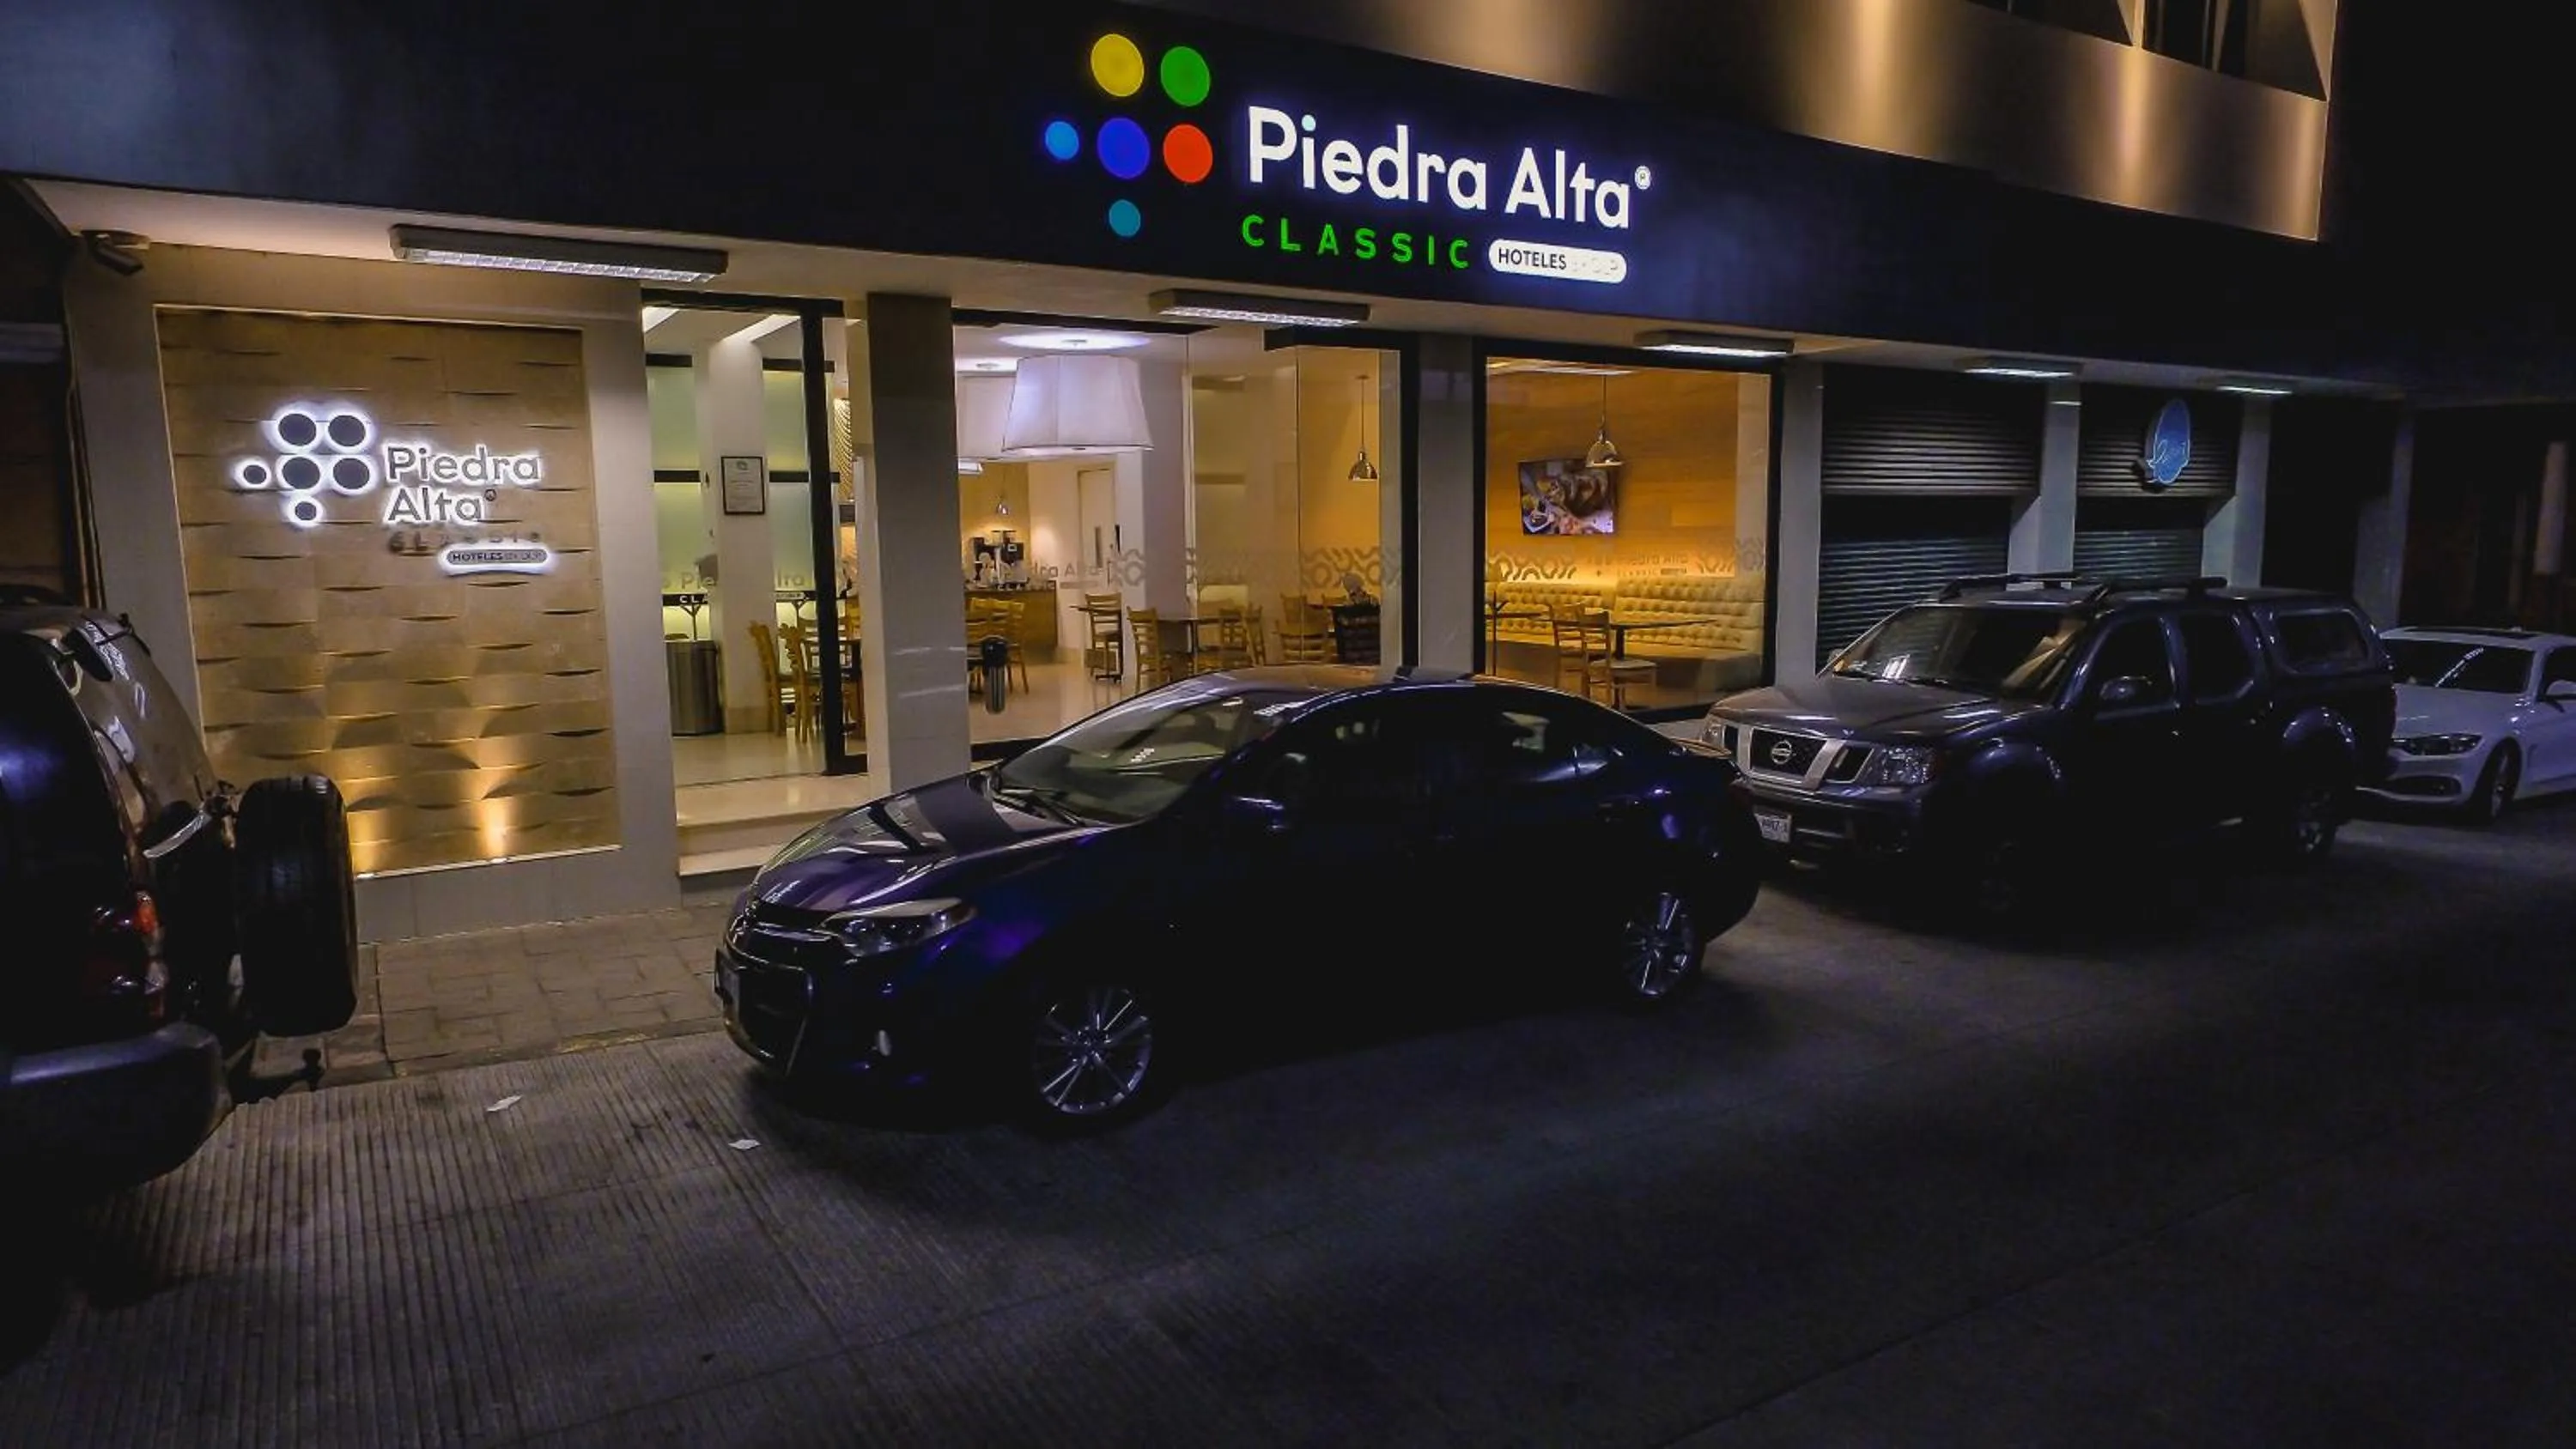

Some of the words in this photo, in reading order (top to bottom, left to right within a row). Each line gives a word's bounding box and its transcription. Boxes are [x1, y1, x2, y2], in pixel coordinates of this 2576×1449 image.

[1248, 105, 1487, 211] Piedra
[1504, 147, 1630, 228] Alta
[1242, 214, 1470, 269] CLASSIC
[1498, 247, 1567, 270] HOTELES
[386, 445, 540, 482] Piedra
[386, 487, 482, 521] Alta
